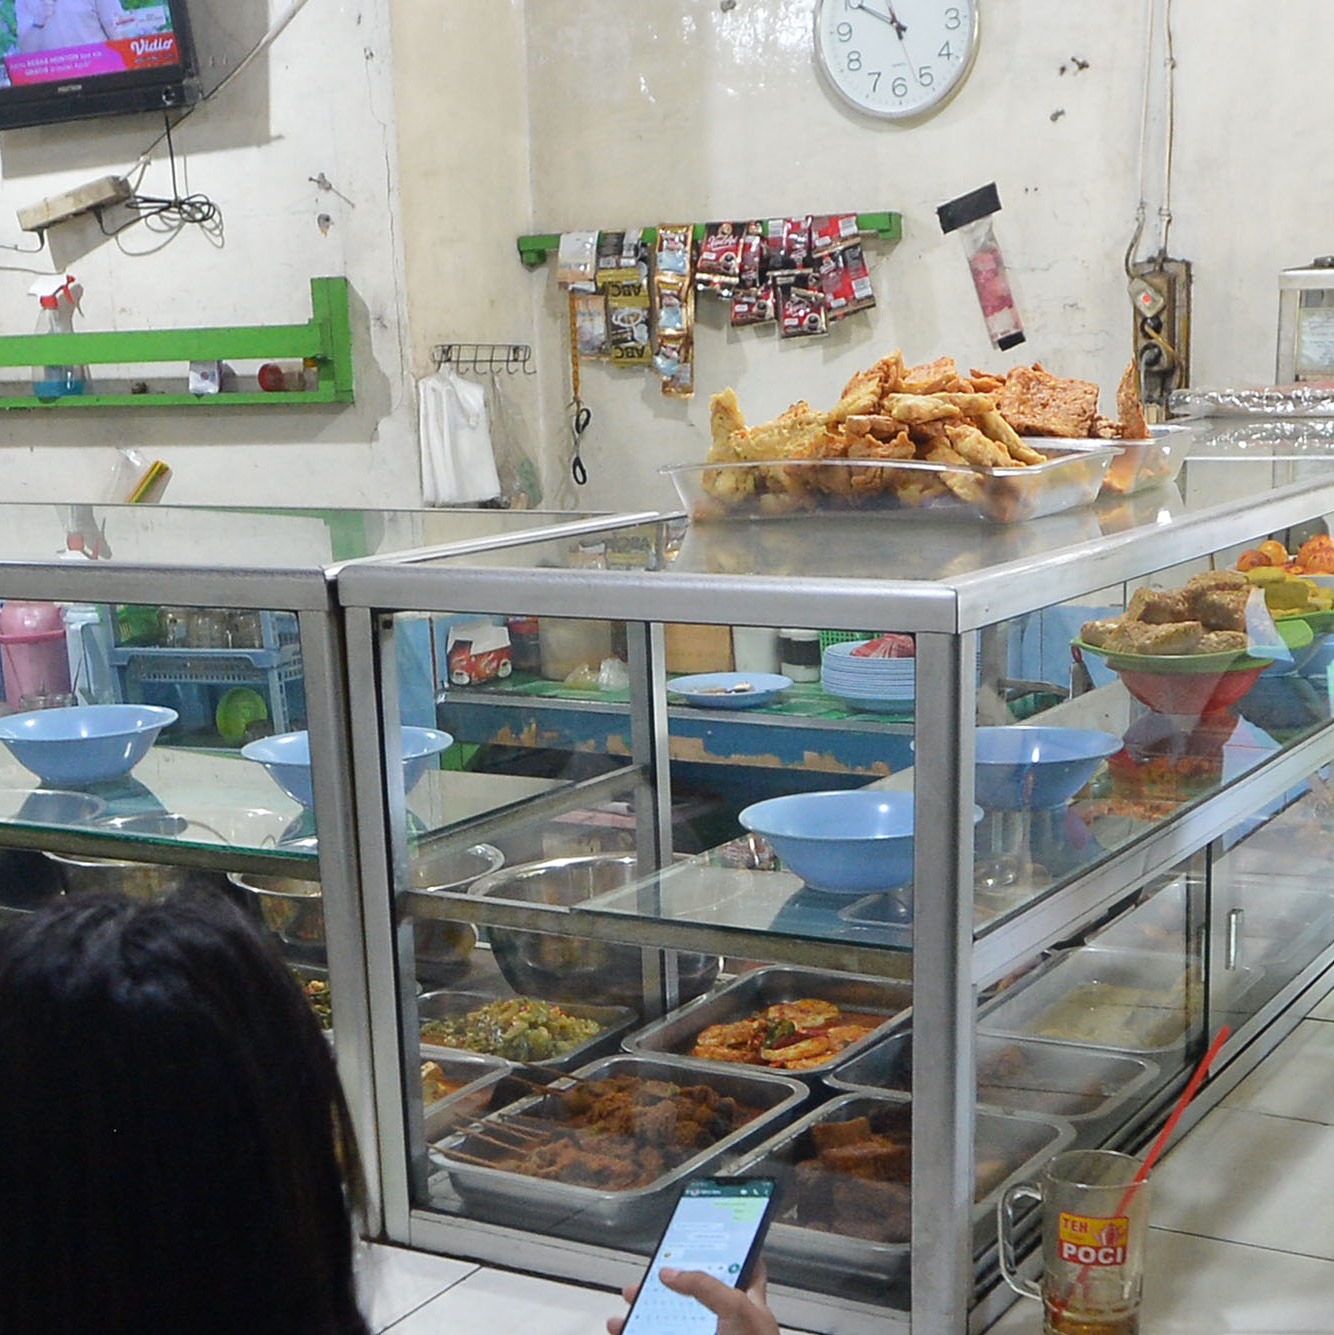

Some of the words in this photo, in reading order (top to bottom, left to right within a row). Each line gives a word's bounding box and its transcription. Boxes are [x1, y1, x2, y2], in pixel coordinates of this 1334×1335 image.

[944, 7, 961, 30] 3
[836, 22, 853, 43] 9
[130, 38, 174, 56] Vidio
[937, 40, 953, 61] 4
[847, 50, 862, 72] 8
[868, 71, 882, 93] 7
[919, 65, 934, 87] 5
[891, 76, 908, 98] 6
[611, 284, 642, 297] ABC
[614, 346, 645, 359] ABC
[1063, 1218, 1089, 1234] TEH
[1062, 1242, 1124, 1265] POCI
